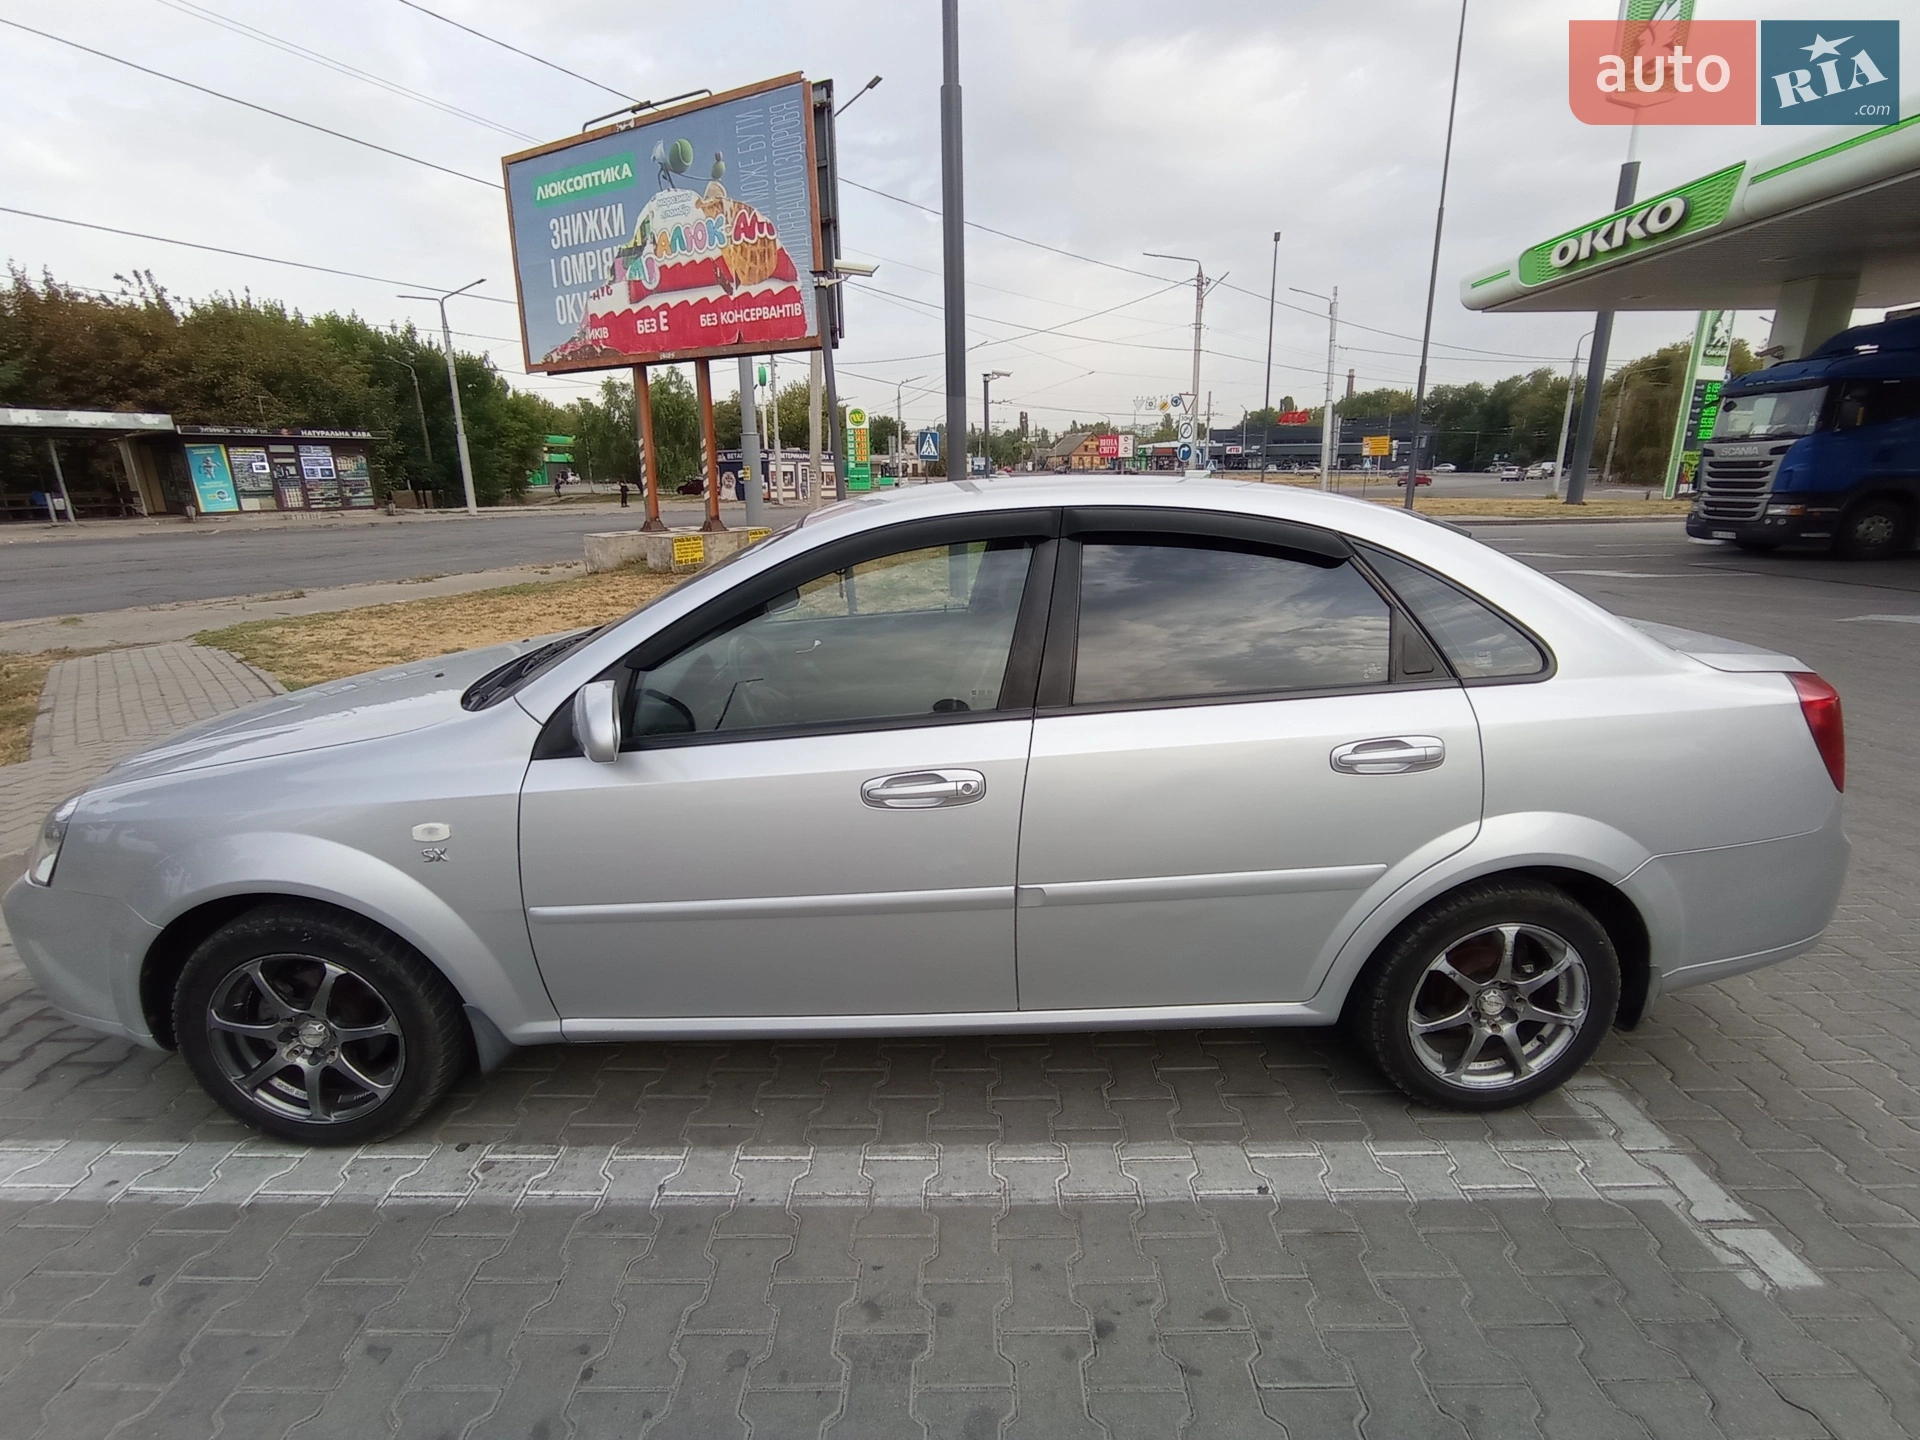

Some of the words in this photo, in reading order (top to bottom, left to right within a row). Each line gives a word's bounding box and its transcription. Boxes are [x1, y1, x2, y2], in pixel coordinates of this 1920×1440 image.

[536, 162, 633, 201] ЛЮКСОПТИКА
[549, 203, 626, 249] ЗНИЖКИ
[1550, 197, 1685, 268] OKKO
[560, 244, 619, 287] ОМРІЯ
[586, 326, 610, 340] ИКІВ
[636, 317, 657, 335] БЕЗ
[700, 313, 718, 328] БЕЗ
[719, 302, 802, 325] КОНСЕРВАНТІВ
[300, 429, 350, 437] НАТУРАЛЬНА
[351, 430, 372, 438] КАВА
[1720, 446, 1759, 456] SCANIA
[421, 847, 450, 863] SX
